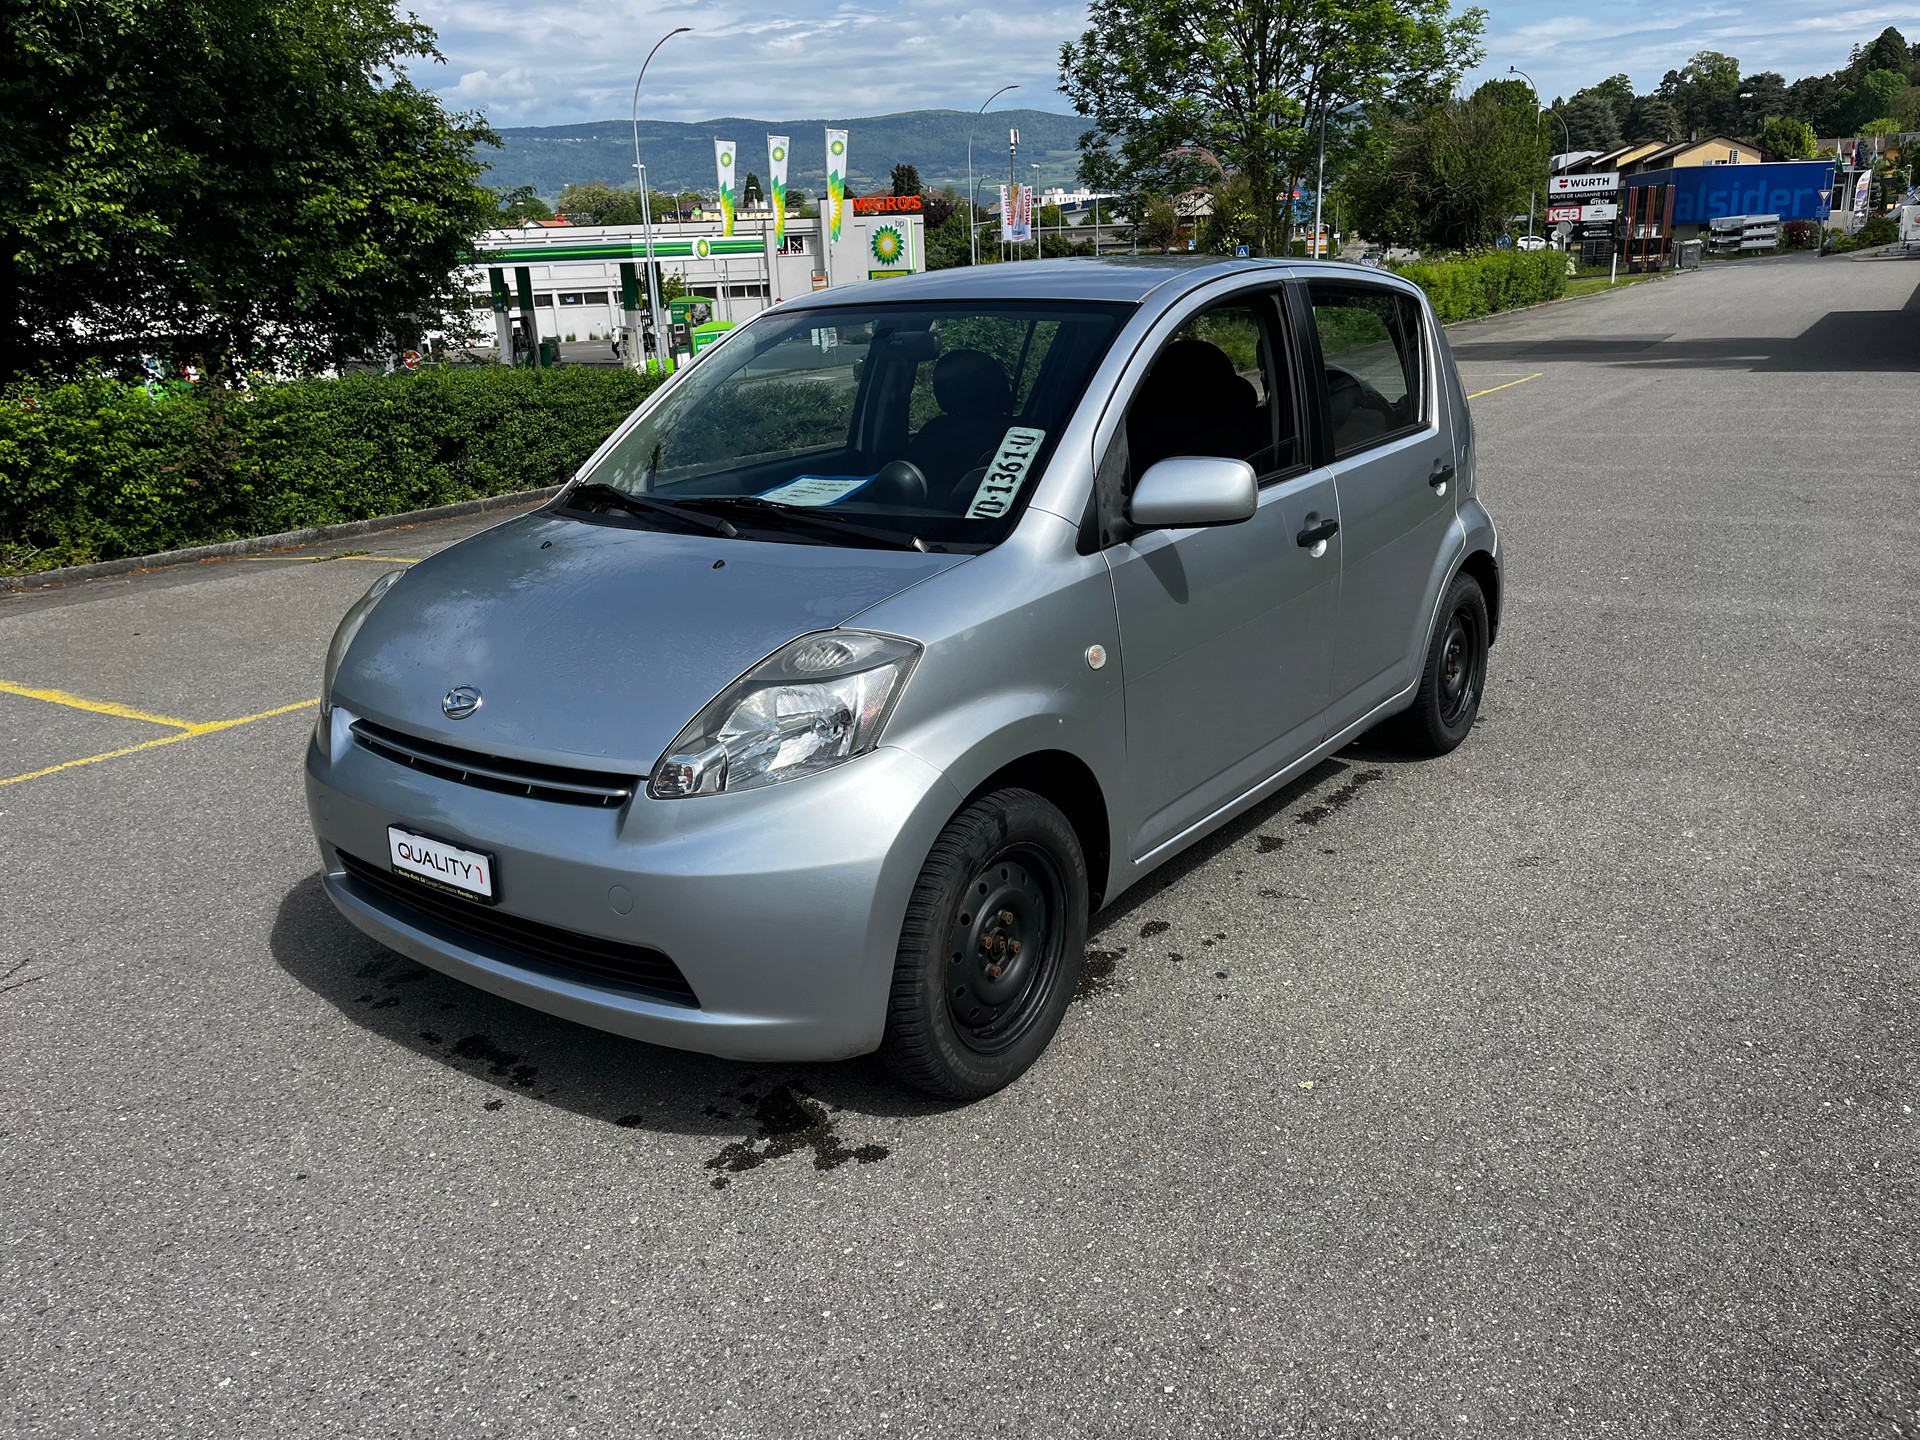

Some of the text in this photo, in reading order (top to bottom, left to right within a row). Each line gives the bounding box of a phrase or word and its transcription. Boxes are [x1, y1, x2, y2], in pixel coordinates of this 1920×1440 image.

[1570, 177, 1610, 188] WÜRTH
[852, 195, 922, 212] MIGROS
[1548, 208, 1580, 222] KEB
[895, 220, 904, 228] bp
[398, 842, 484, 884] QUALITY 1
